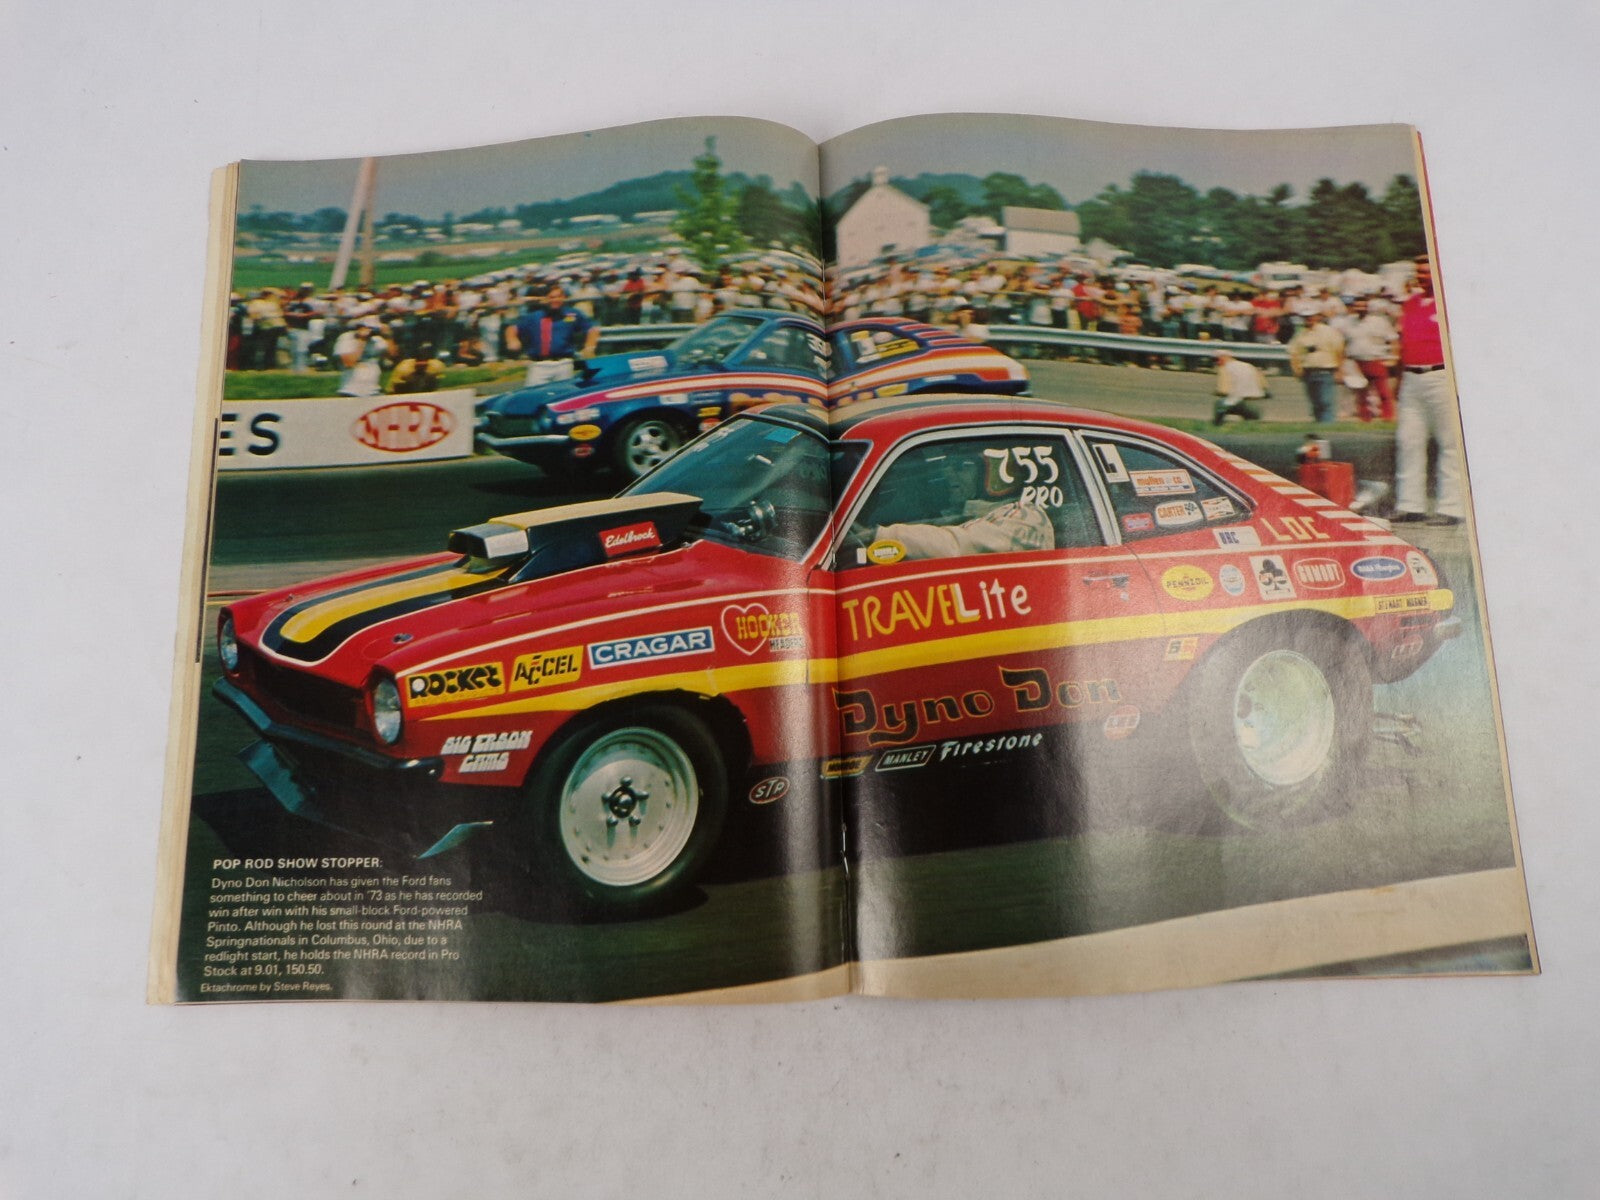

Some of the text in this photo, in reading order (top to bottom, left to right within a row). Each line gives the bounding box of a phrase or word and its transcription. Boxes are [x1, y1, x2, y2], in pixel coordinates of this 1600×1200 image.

[983, 446, 1059, 484] 755
[1021, 485, 1063, 509] PRO
[605, 527, 656, 548] Edelbrock
[1166, 576, 1210, 589] PENNZOIL
[595, 632, 707, 663] CRAGAR
[832, 665, 1121, 747] Dyno Don
[941, 732, 1043, 762] Firestone
[883, 750, 929, 766] MANLEY
[755, 778, 785, 799] STP
[213, 857, 383, 869] POP ROD SHOW STOPPER:
[211, 875, 452, 890] Dyno Don Nicholson has given the Ford fans
[210, 890, 483, 904] something to cheer about in '73 as he has recorded
[208, 904, 468, 917] win after win with his small-block Ford-powered
[207, 919, 463, 933] Pinto. Although he lost this round at the NHRA
[206, 934, 448, 949] Springnationals in Columbus, Ohio, due to a
[204, 949, 460, 963] redlight start, he holds the NHRA record in Pro
[203, 963, 324, 977] Stock at 9.01, 150.50.
[200, 981, 333, 993] Ektachrome by Steve Reyes.
